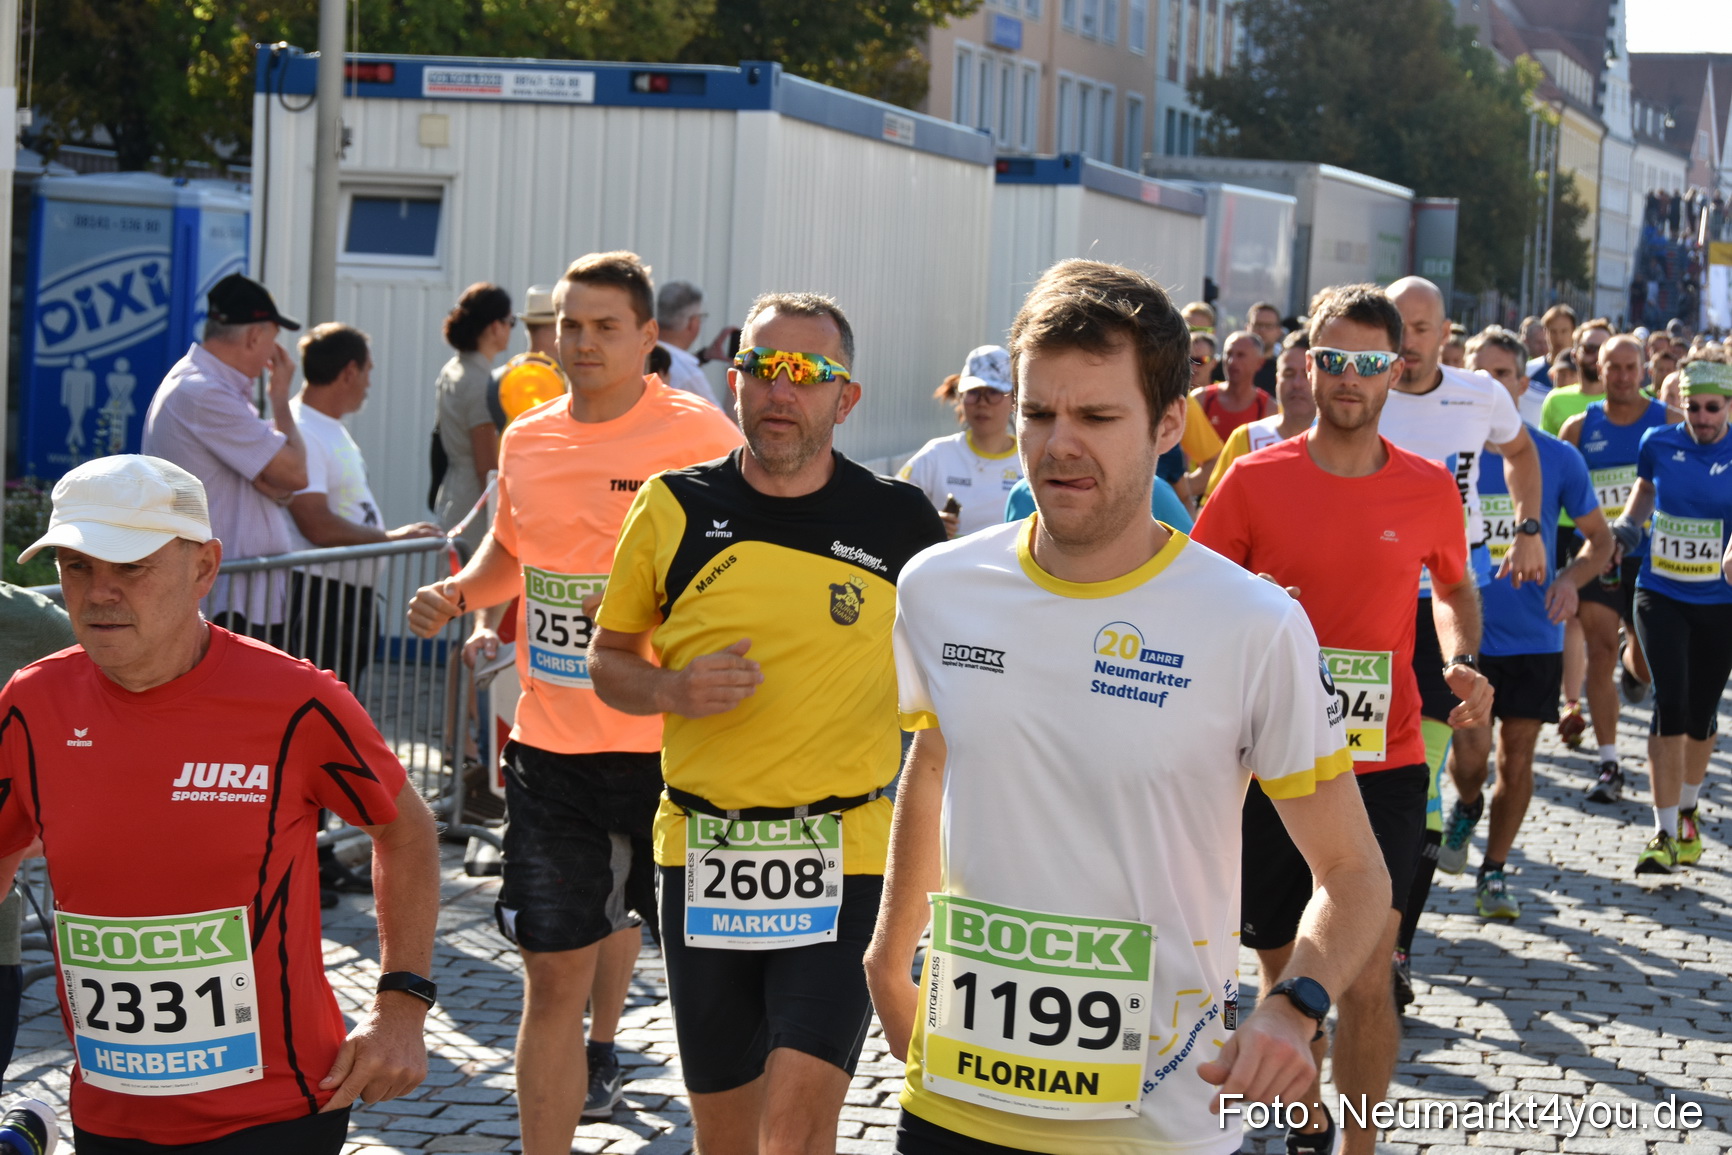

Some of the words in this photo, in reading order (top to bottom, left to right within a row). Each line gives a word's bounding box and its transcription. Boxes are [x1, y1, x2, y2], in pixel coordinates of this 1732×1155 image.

[1598, 486, 1632, 506] 113
[705, 529, 733, 538] erima
[1658, 535, 1713, 560] 1134
[695, 555, 738, 594] Markus
[1658, 559, 1714, 574] JOHANNES
[534, 608, 593, 649] 253
[832, 606, 855, 623] THANN
[943, 643, 1005, 667] BOCK
[1098, 630, 1140, 661] 20
[1141, 650, 1181, 667] JAHRE
[536, 652, 589, 675] CHRIST
[1093, 660, 1192, 689] Neumarkter
[1090, 679, 1169, 708] Stadtlauf
[1336, 689, 1374, 722] 04
[67, 739, 93, 747] erima
[172, 762, 269, 790] JURA
[171, 791, 267, 803] SPORT-Service
[699, 818, 826, 845] BOCK
[828, 860, 835, 868] B
[704, 858, 825, 901] 2608
[712, 914, 812, 933] MARKUS
[68, 919, 231, 964] BOCK
[948, 904, 1131, 972] BOCK
[235, 977, 245, 987] C
[81, 976, 226, 1034] 2331
[953, 971, 1122, 1051] 1199
[1131, 998, 1140, 1009] B
[95, 1045, 229, 1075] HERBERT
[1155, 1017, 1206, 1081] September
[957, 1051, 1100, 1097] FLORIAN
